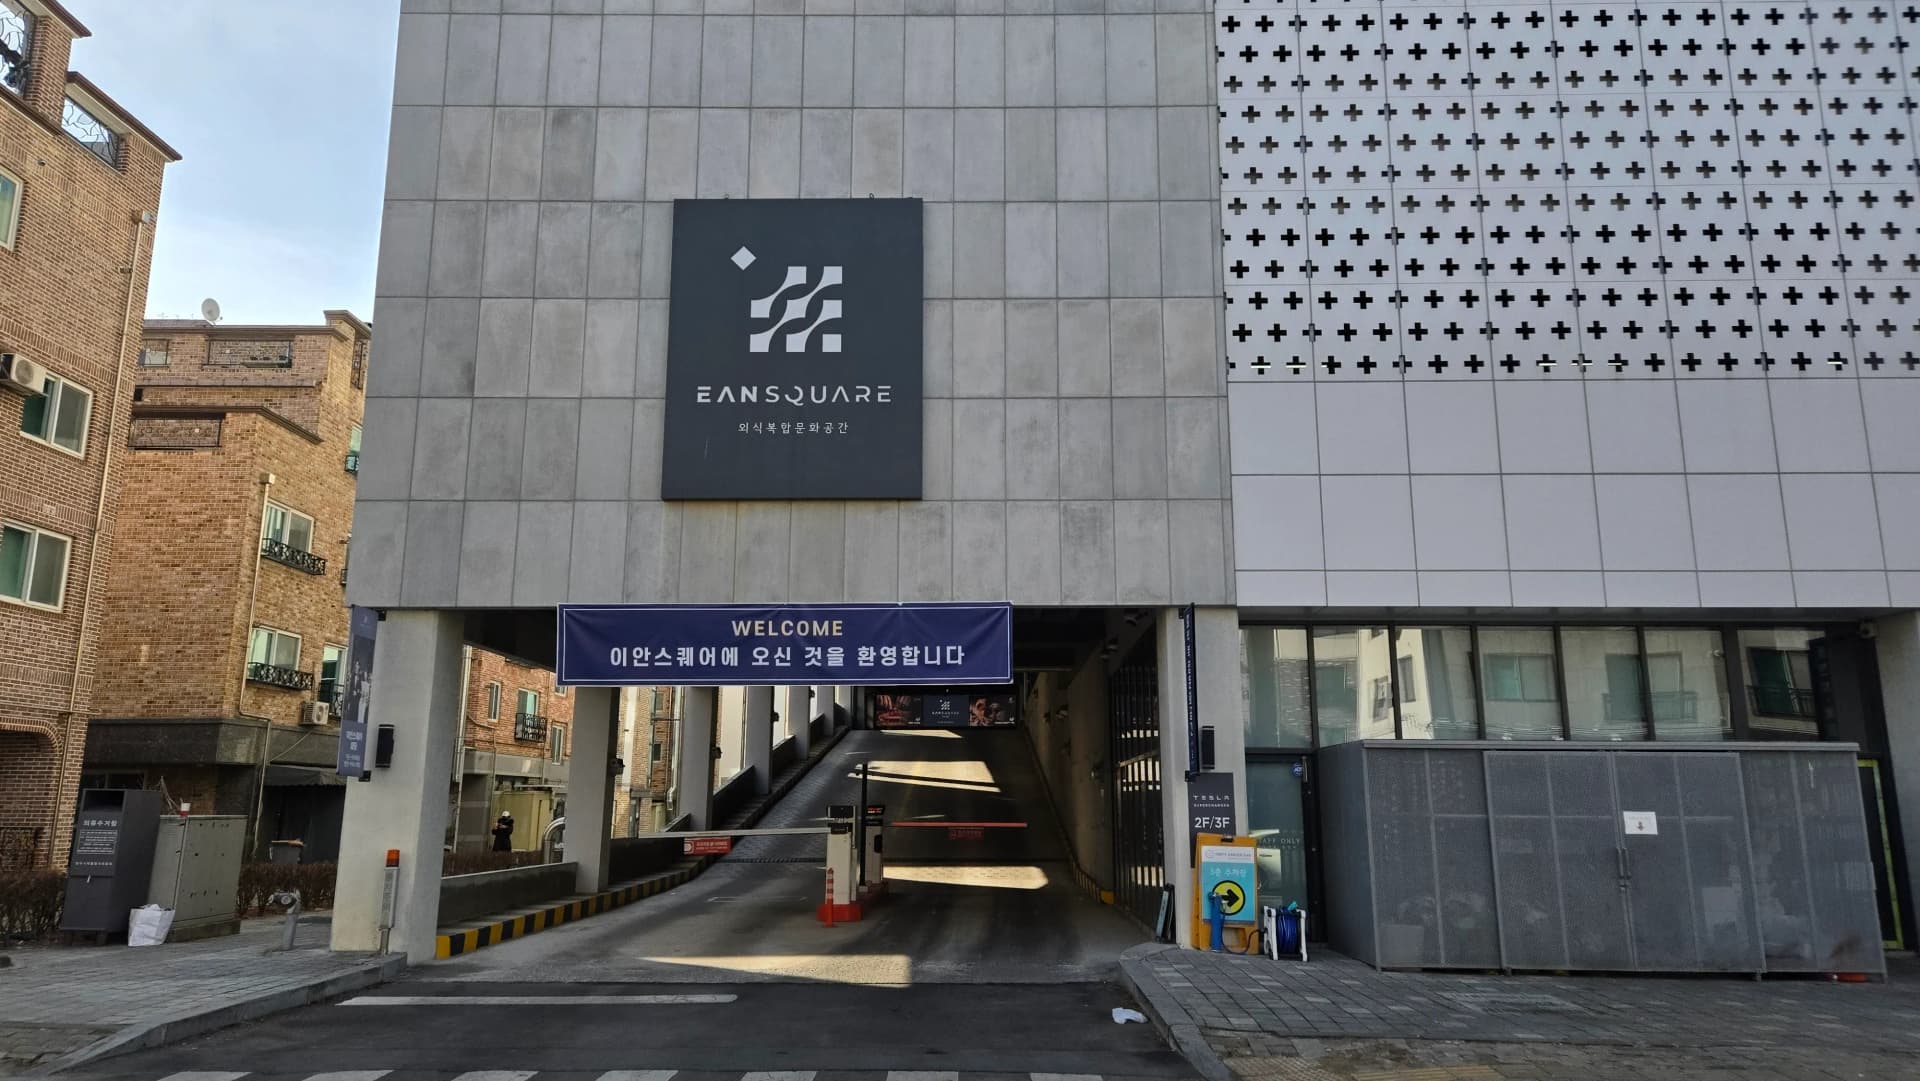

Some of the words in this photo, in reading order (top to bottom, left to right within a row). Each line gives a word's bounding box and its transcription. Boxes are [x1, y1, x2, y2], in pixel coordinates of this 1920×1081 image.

[696, 385, 892, 406] EANSQUARE
[738, 421, 849, 434] 외식복합문화공간
[732, 620, 844, 637] WELCOME
[610, 646, 739, 667] 이안스퀘어에
[751, 646, 792, 667] 오신
[804, 646, 846, 667] 것을
[857, 645, 966, 667] 환영합니다
[1194, 816, 1230, 830] 2F/3F
